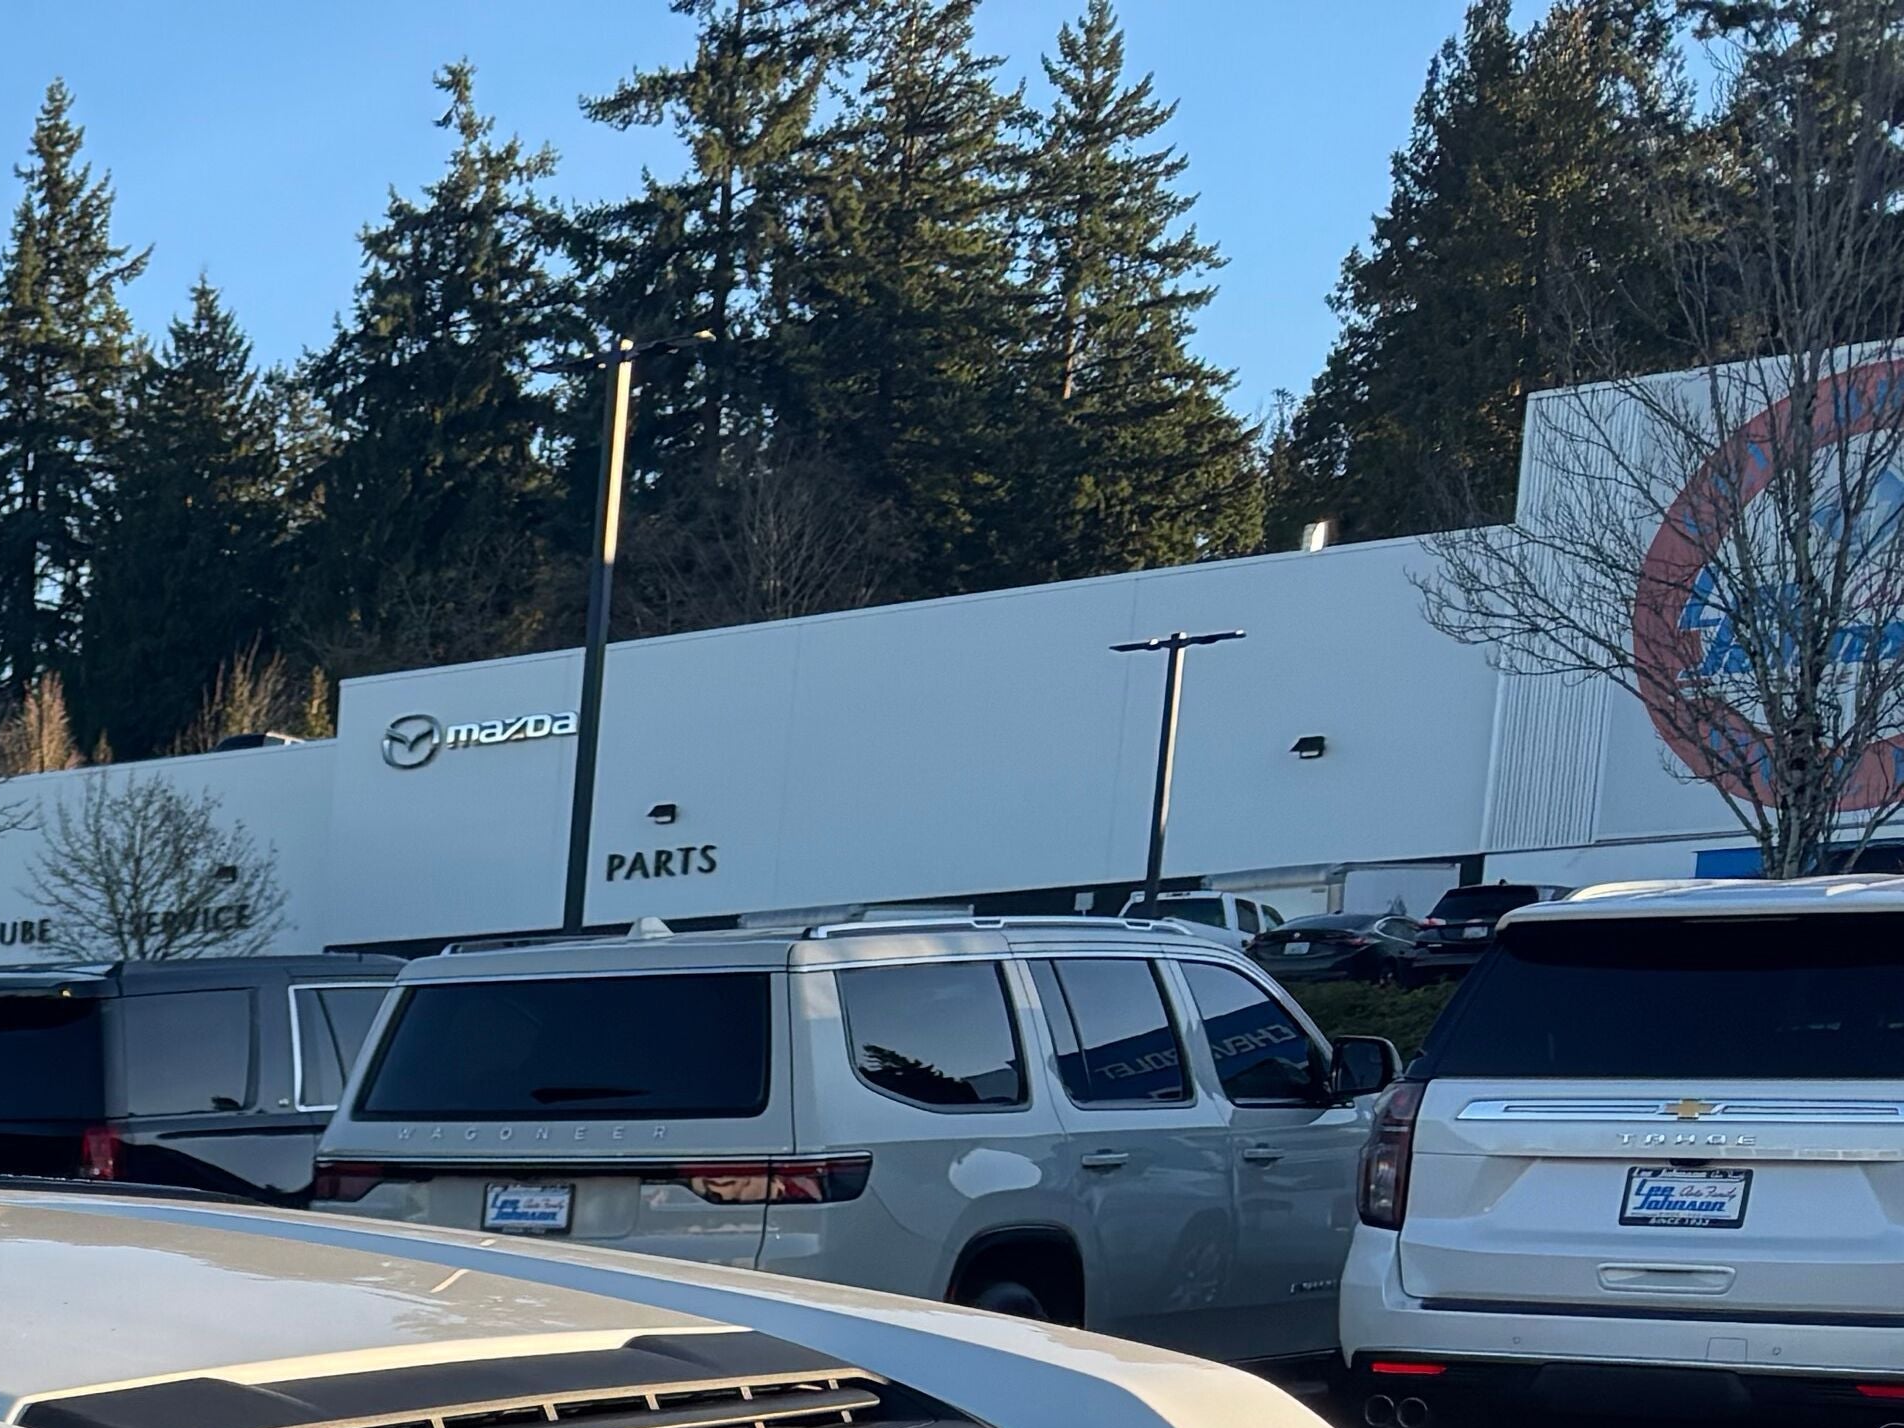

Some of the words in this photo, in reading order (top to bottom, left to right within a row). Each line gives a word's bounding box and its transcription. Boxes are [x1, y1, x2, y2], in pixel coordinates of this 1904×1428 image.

[605, 845, 718, 882] PARTS
[397, 1126, 667, 1140] WAGONEER
[1617, 1133, 1758, 1146] TAHOE
[1634, 1179, 1675, 1197] Lee
[1633, 1195, 1727, 1212] Johnson
